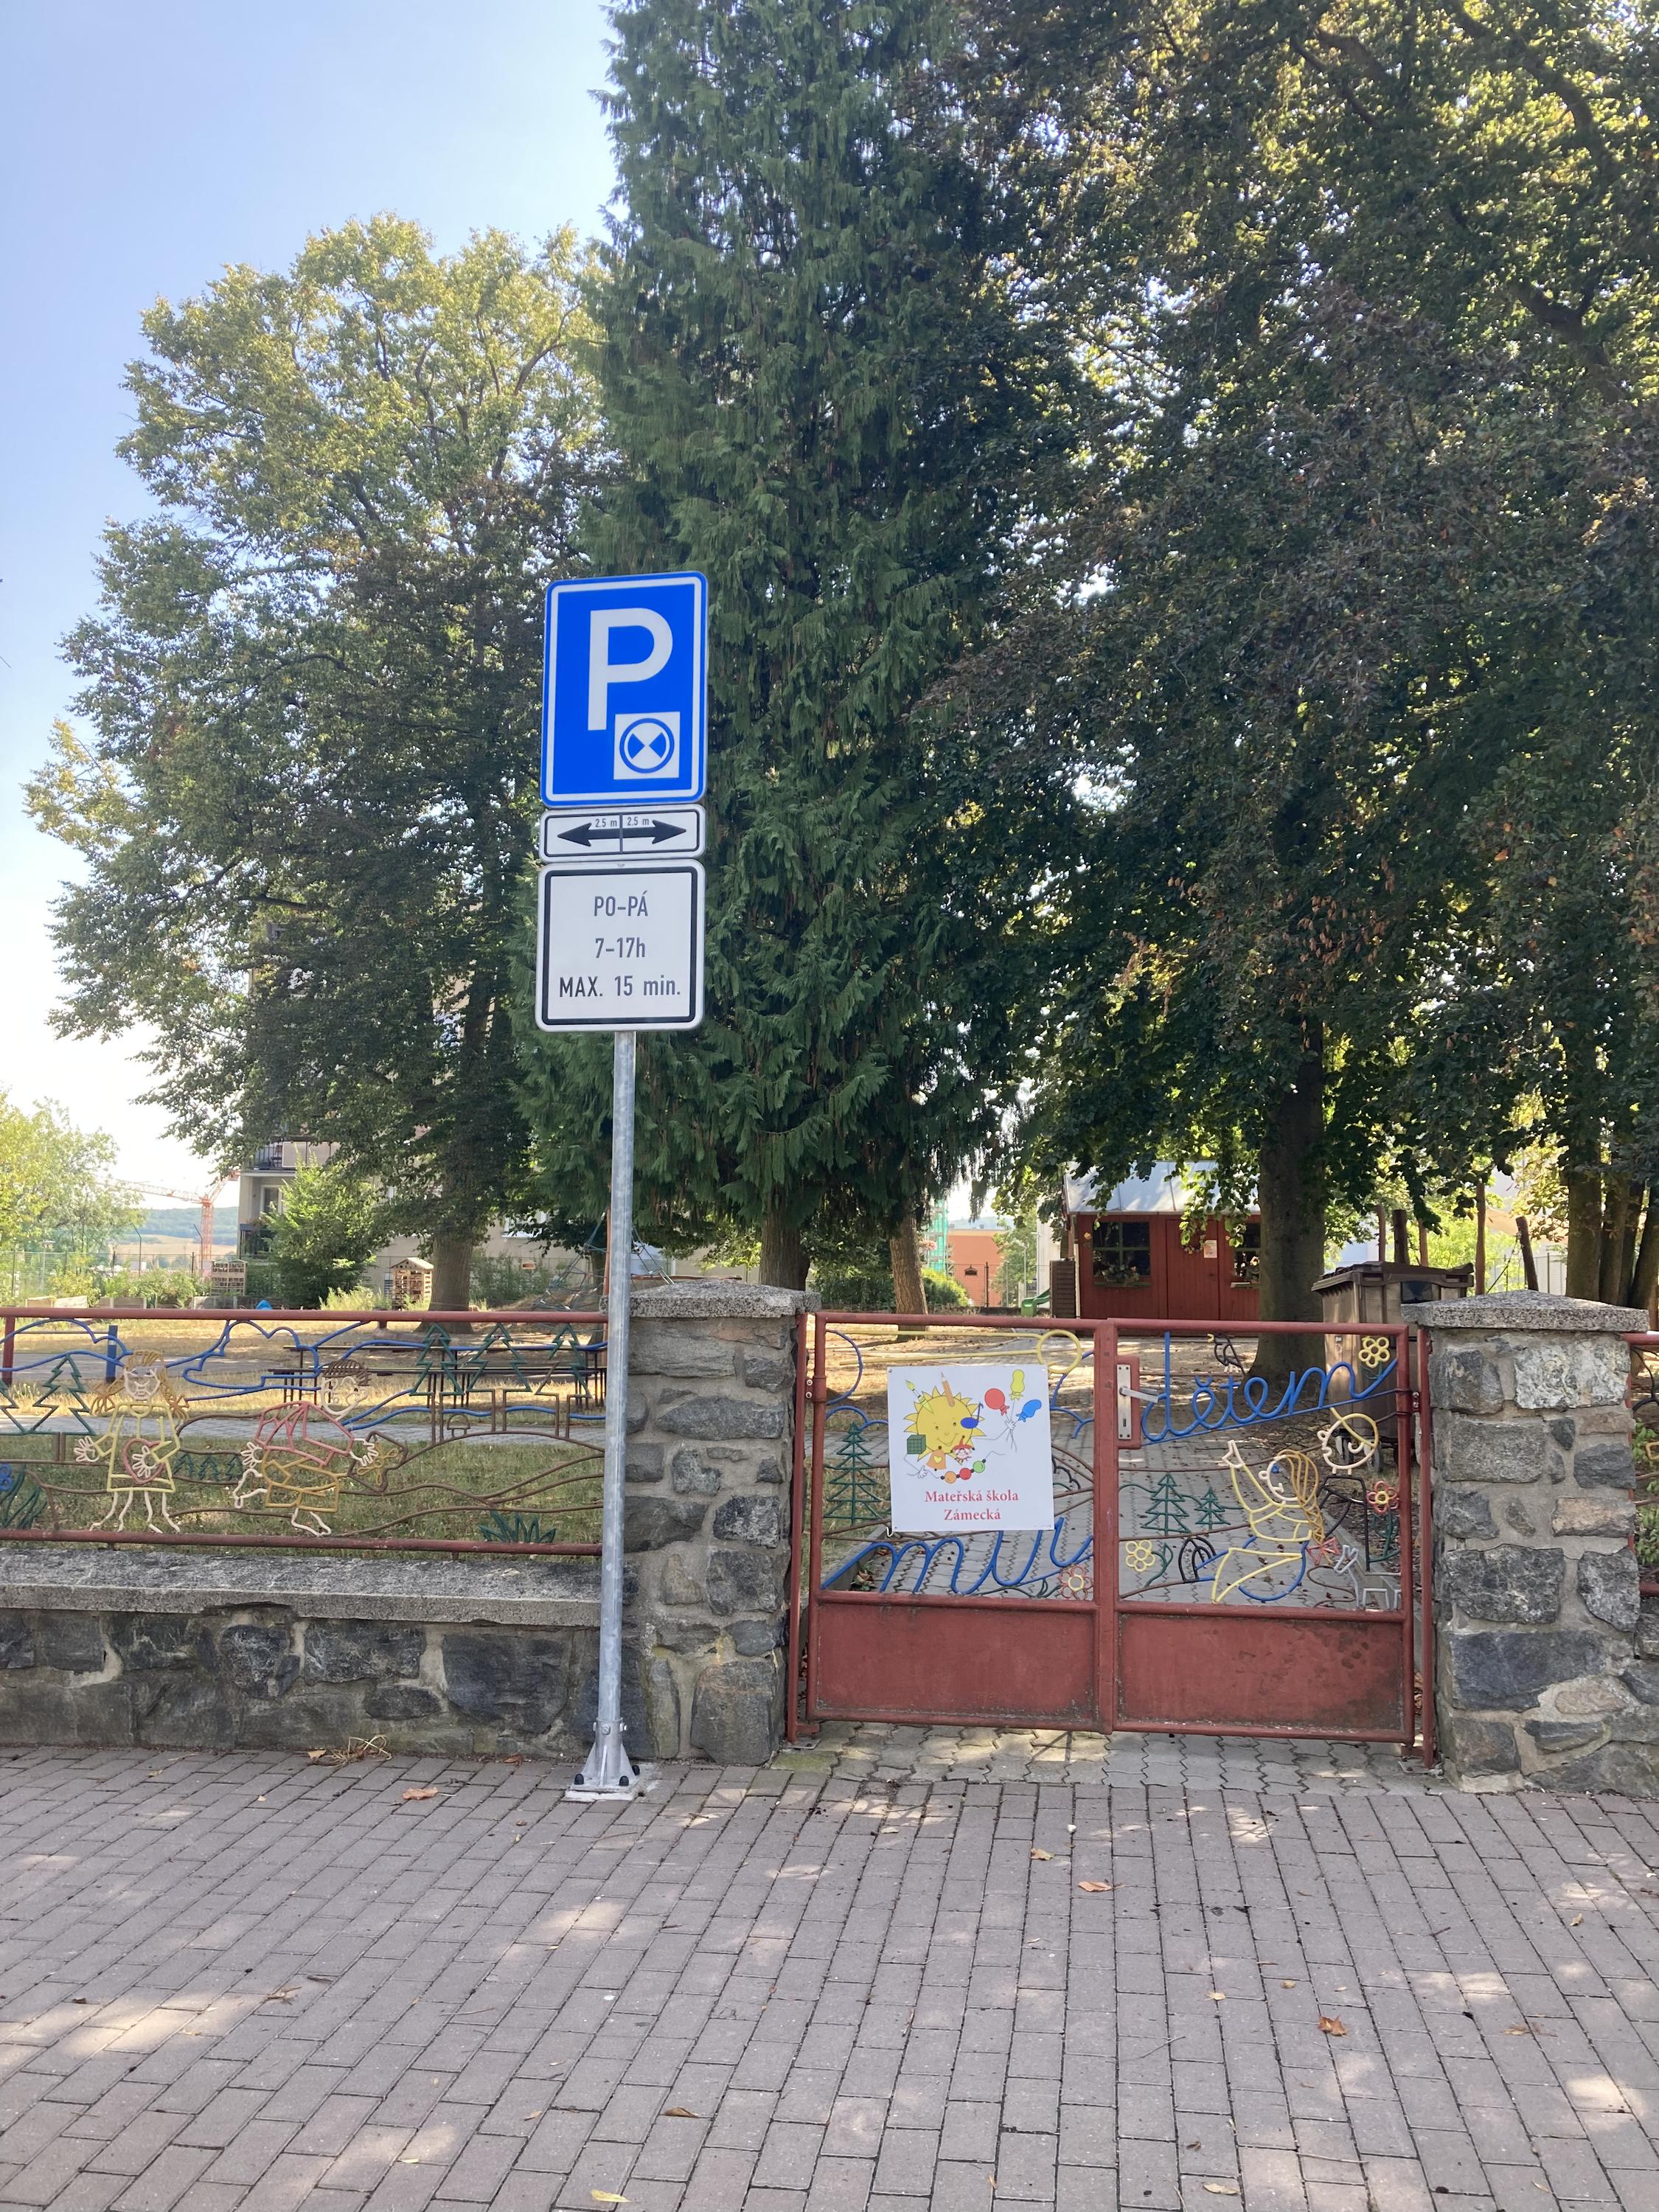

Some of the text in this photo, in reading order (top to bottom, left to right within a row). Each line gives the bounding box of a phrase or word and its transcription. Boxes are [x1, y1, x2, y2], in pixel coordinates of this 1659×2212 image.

[588, 608, 673, 731] P
[642, 818, 650, 826] m
[594, 890, 648, 917] PO-PÁ
[595, 937, 646, 959] 7-17h
[559, 974, 681, 998] MAX. 15 min.
[925, 1489, 1019, 1503] Mateřská škola
[943, 1509, 1001, 1520] Zámecká
